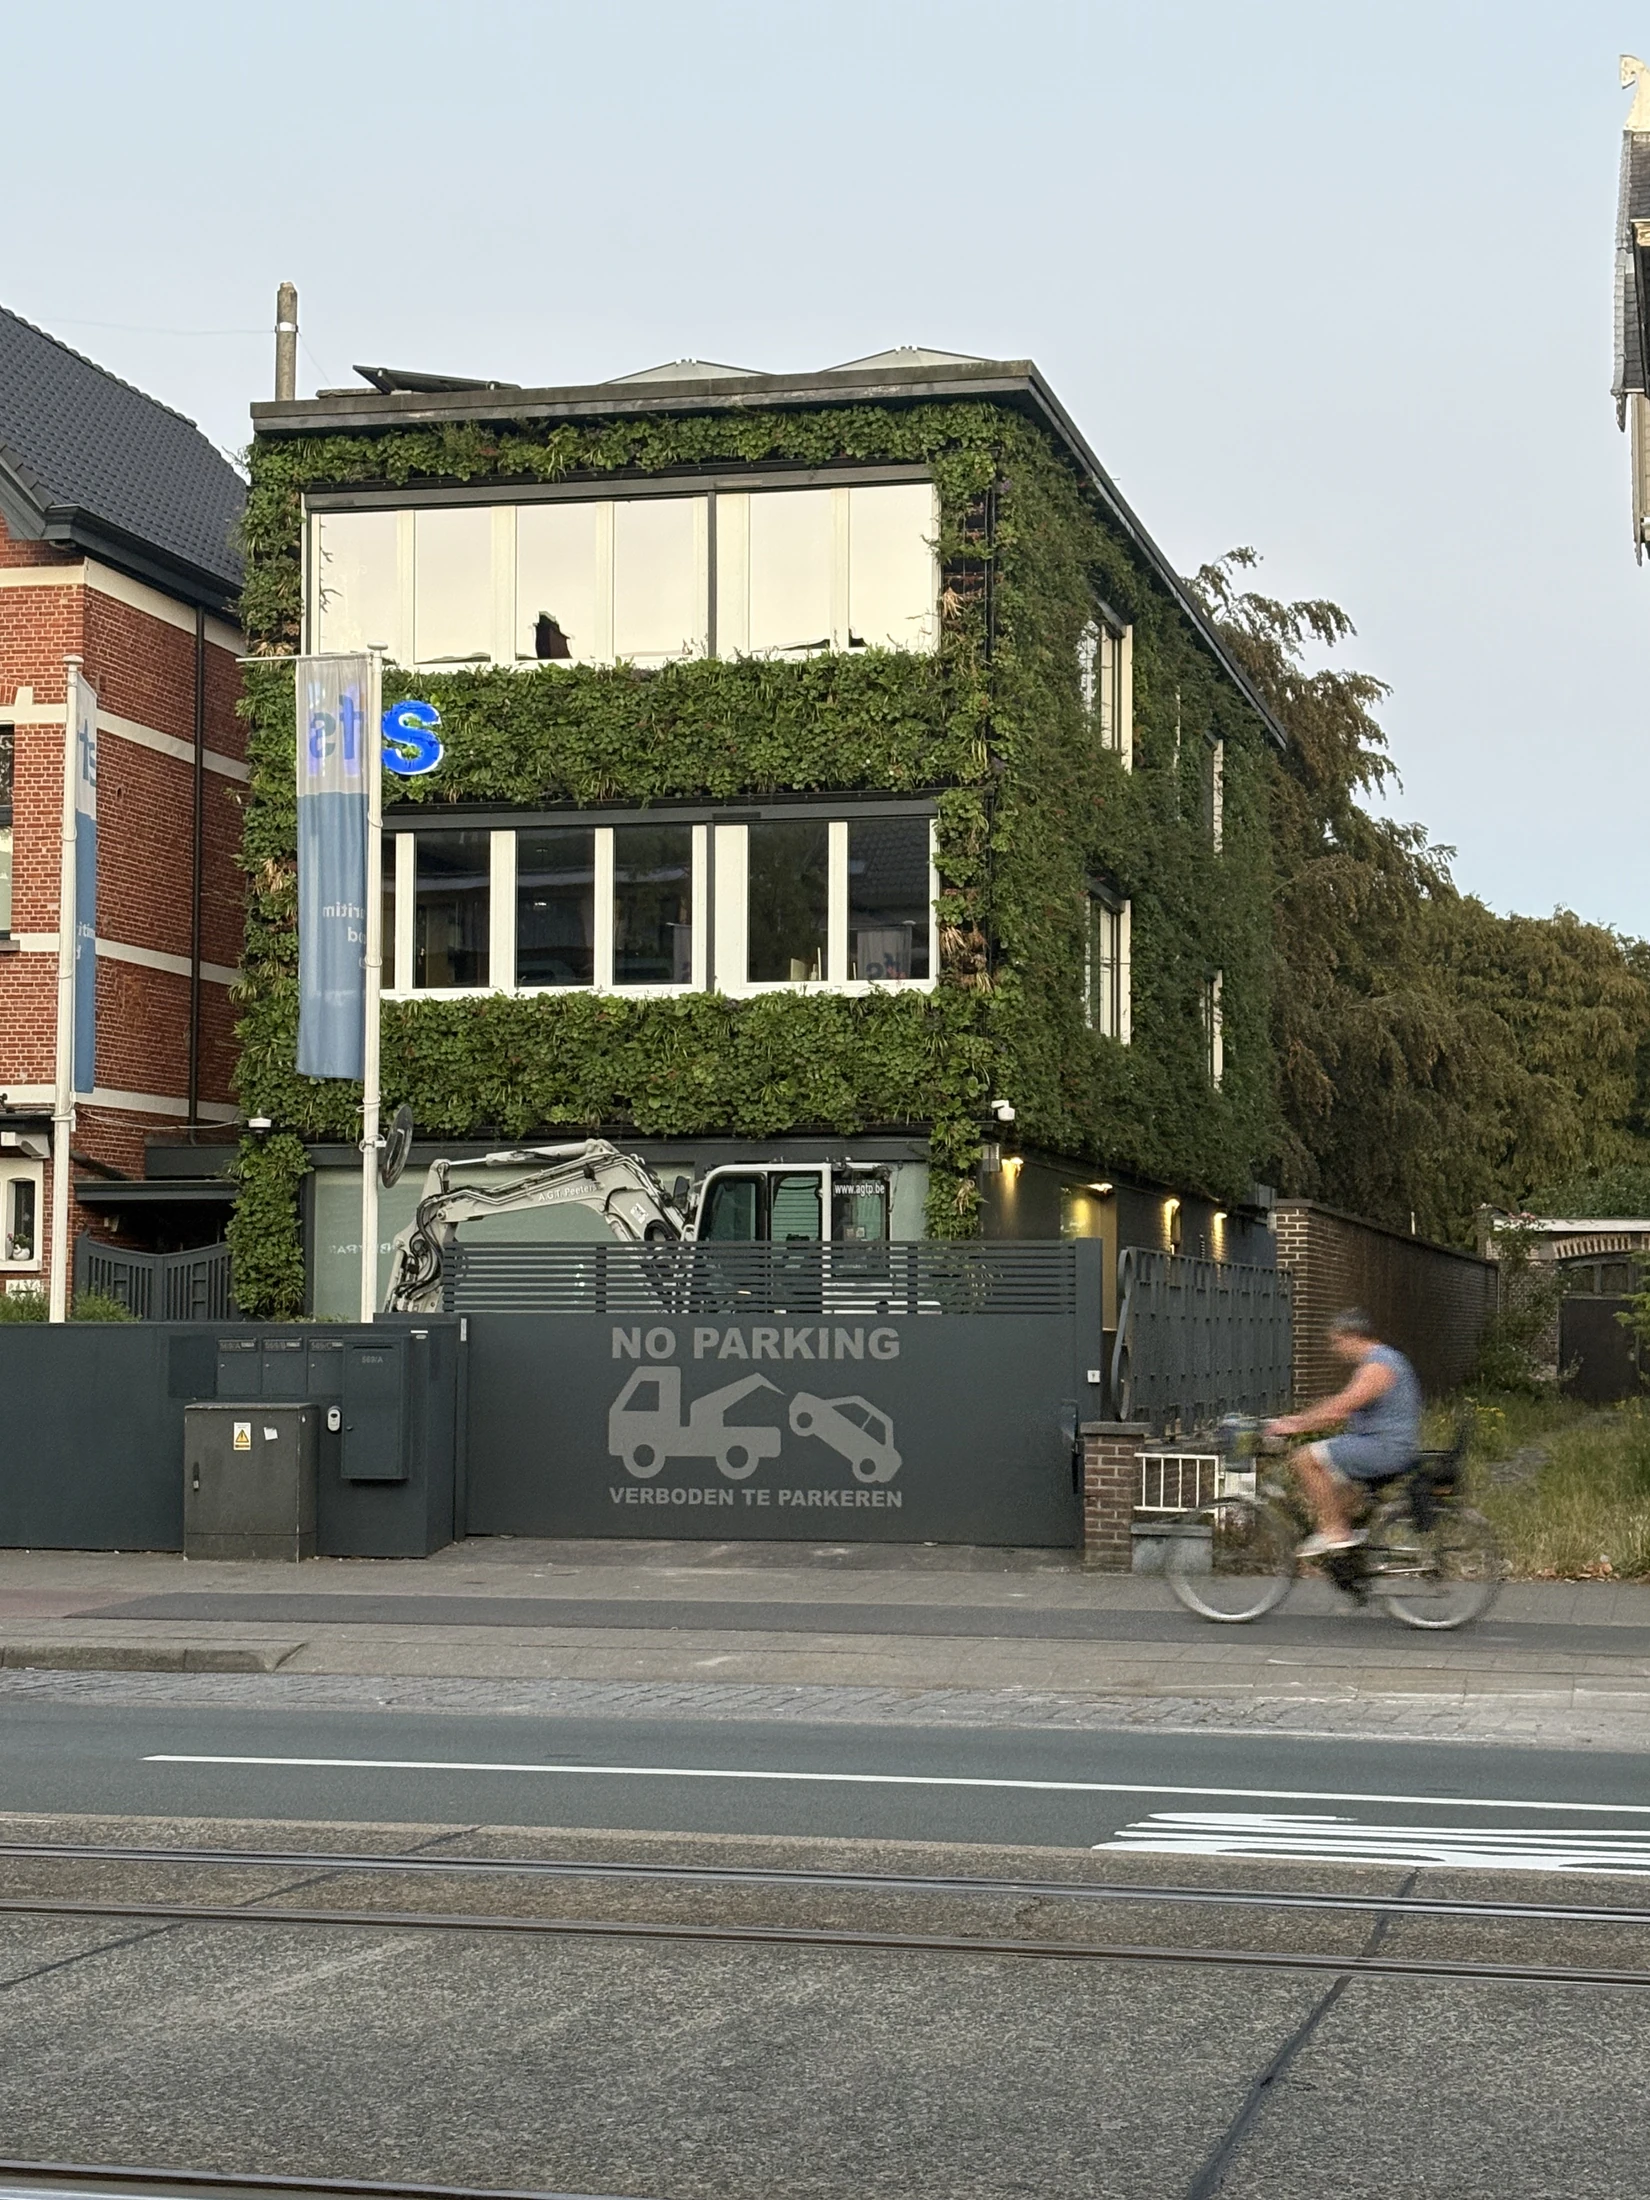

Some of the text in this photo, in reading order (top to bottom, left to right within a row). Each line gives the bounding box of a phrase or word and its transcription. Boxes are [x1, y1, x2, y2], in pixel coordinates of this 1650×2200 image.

[564, 1183, 597, 1197] Peeters
[835, 1182, 885, 1198] www.agtp.be
[612, 1327, 900, 1360] NO PARKING
[609, 1487, 903, 1508] VERBODEN TE PARKEREN
